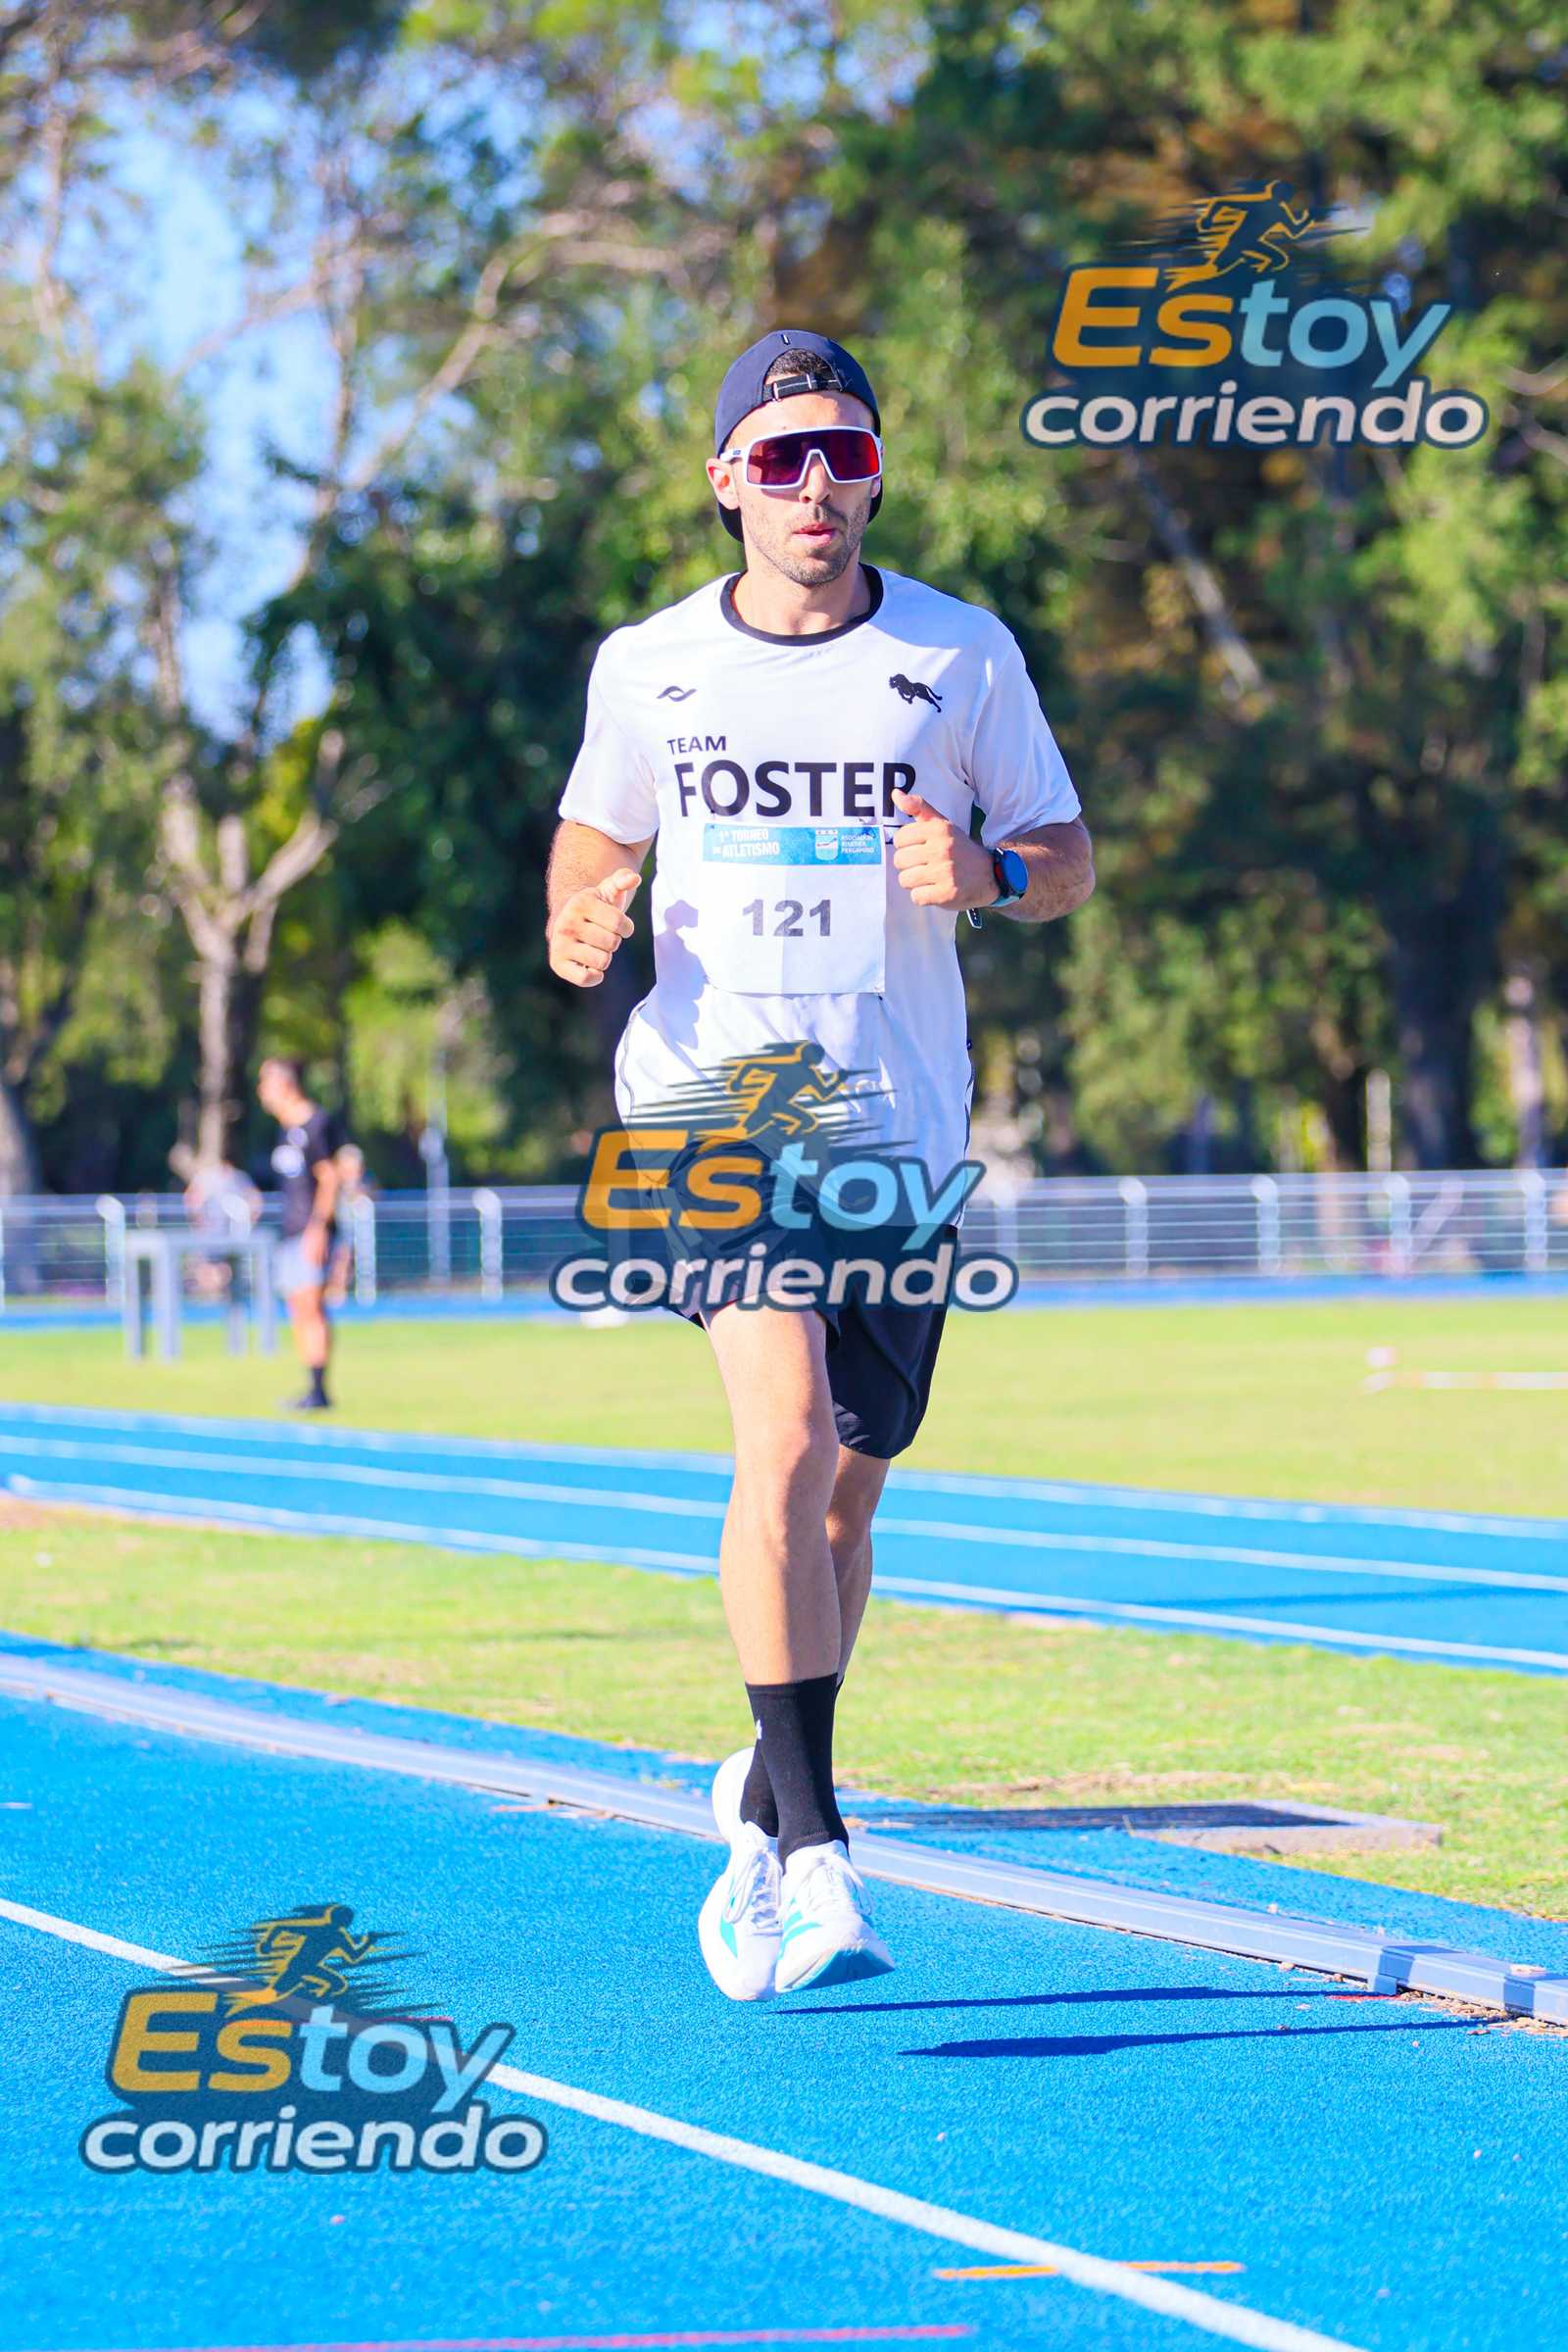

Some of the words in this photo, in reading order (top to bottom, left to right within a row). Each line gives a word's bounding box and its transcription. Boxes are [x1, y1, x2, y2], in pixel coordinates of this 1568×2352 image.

[666, 735, 727, 756] TEAM
[673, 759, 917, 818] FOSTER
[730, 827, 769, 843] TORNEO
[721, 841, 781, 858] ATLETISMO
[742, 899, 831, 937] 121
